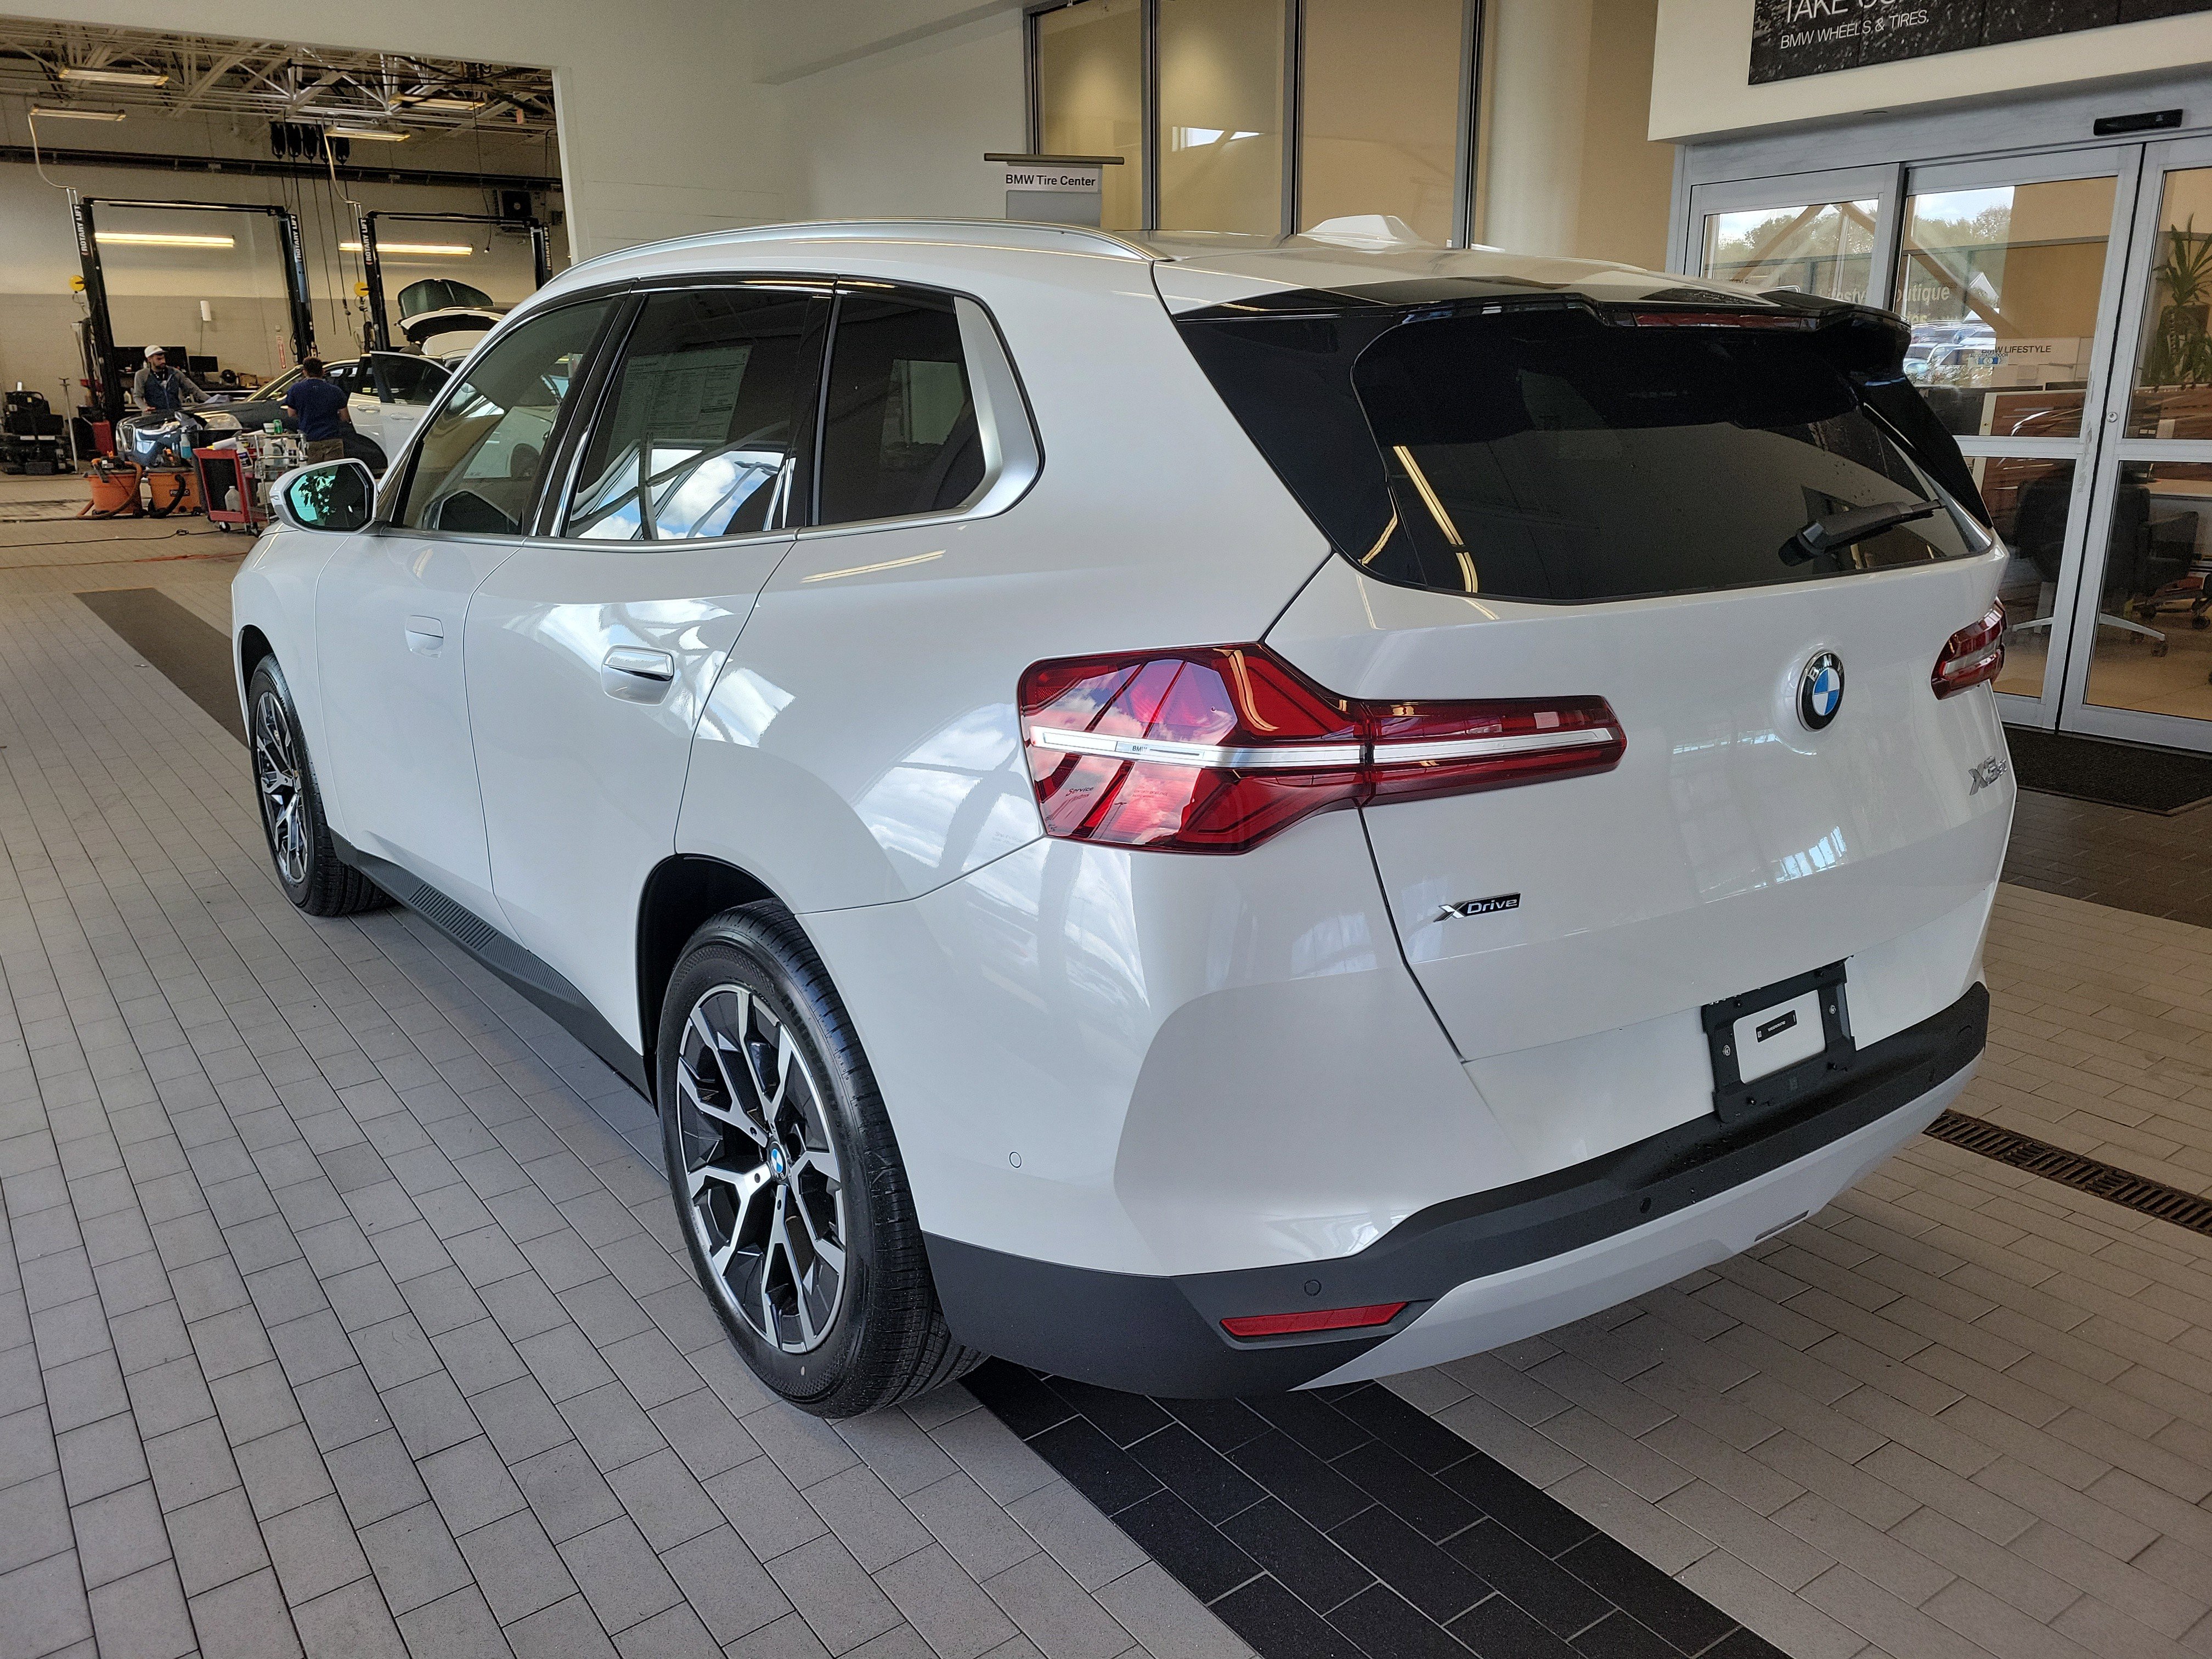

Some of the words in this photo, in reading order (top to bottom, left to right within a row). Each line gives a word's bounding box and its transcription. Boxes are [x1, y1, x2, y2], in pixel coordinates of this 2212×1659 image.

[1780, 30, 1815, 49] BMW
[1817, 20, 1872, 42] WHEELS
[1875, 18, 1885, 32] &
[1888, 9, 1929, 29] TIRES.
[1006, 174, 1034, 184] BMW
[1036, 175, 1058, 185] Tire
[1060, 176, 1096, 187] Center
[74, 205, 82, 221] LIFT
[77, 222, 88, 251] ROTARY
[360, 219, 368, 233] LIFT
[293, 231, 302, 258] ROTARY
[362, 234, 373, 261] ROTARY
[2004, 345, 2052, 353] LIFESTYLE
